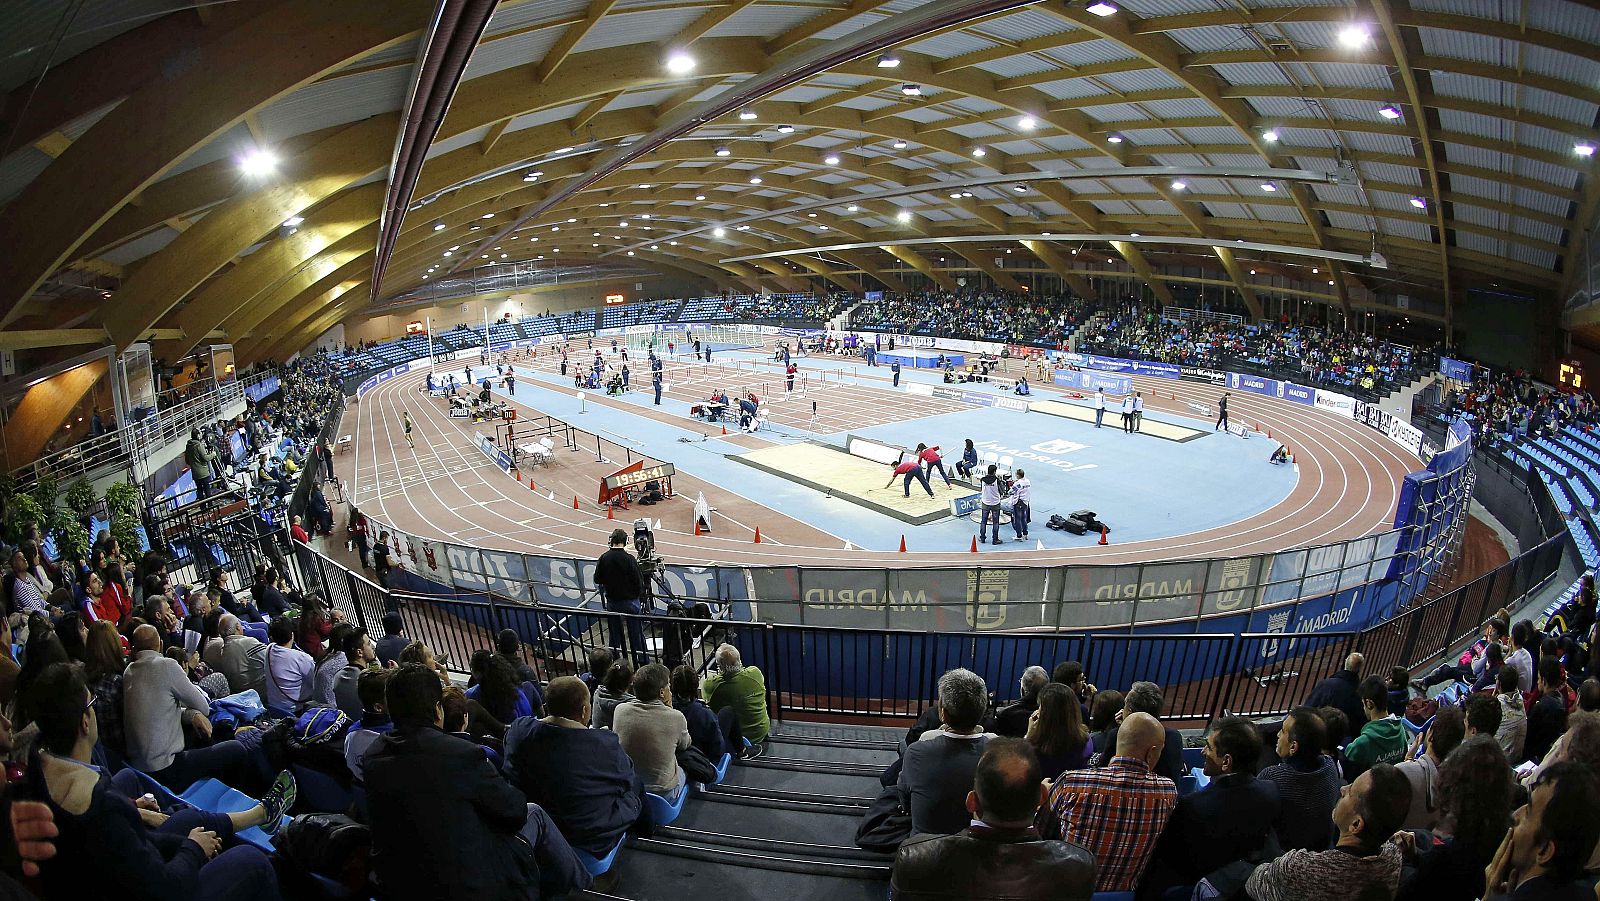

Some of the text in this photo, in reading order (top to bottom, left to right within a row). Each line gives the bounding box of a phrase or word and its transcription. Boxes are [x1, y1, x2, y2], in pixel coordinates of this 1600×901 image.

[5, 353, 12, 369] H
[1244, 379, 1264, 389] MADRID
[1288, 388, 1308, 399] MADRID
[615, 465, 665, 486] 19:56:41
